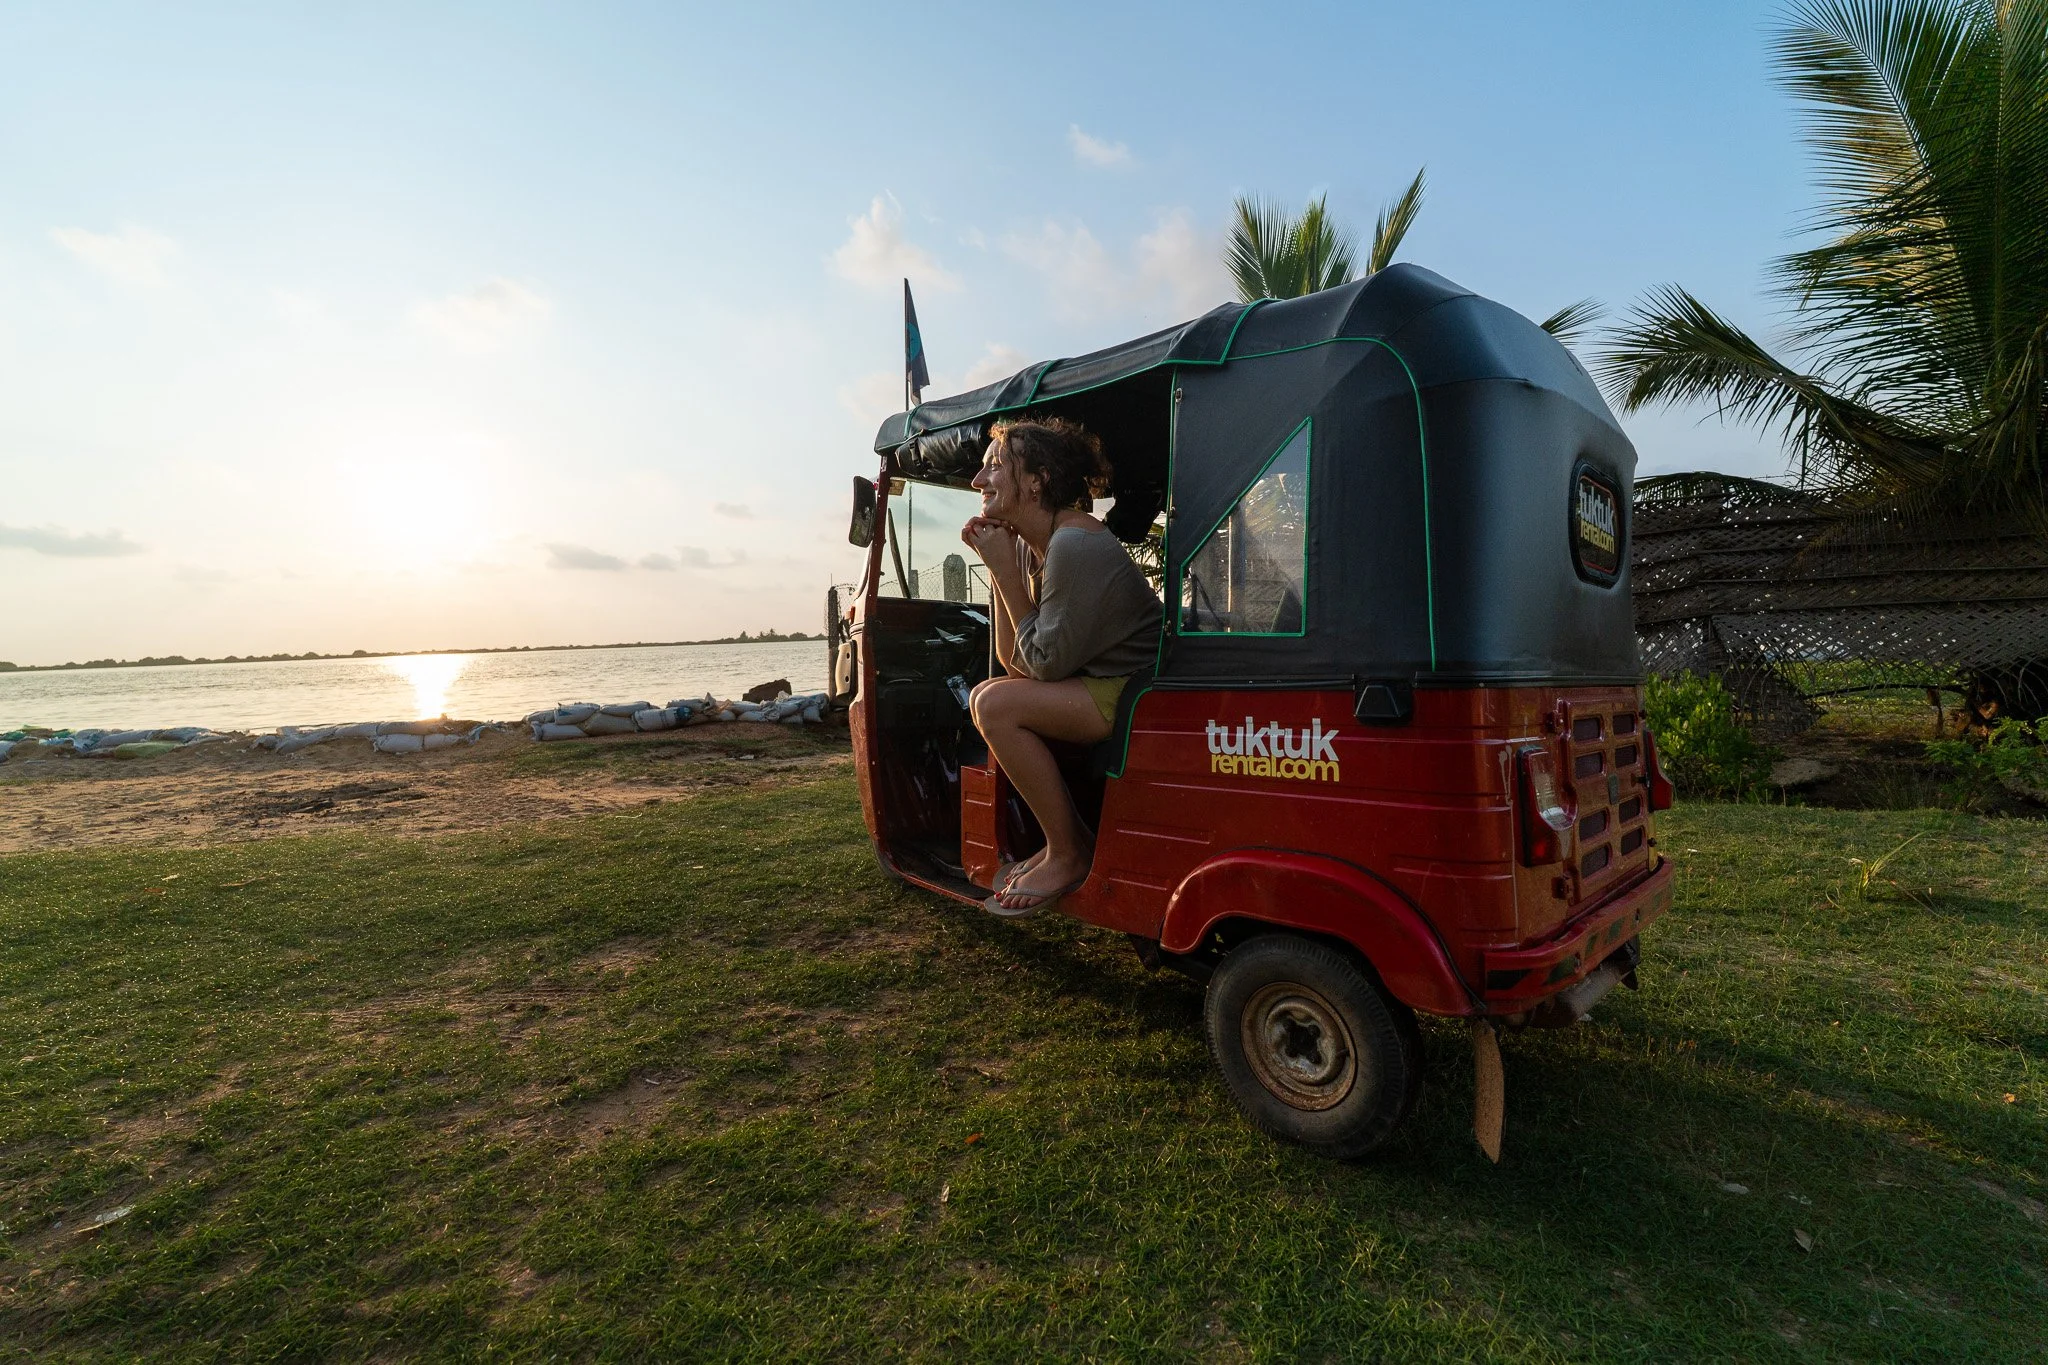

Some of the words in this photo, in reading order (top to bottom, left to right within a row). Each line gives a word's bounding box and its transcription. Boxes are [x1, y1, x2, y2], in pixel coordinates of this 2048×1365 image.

[1579, 482, 1615, 536] tuktuk
[1206, 716, 1339, 761] tuktuk
[1211, 754, 1340, 782] rental.com
